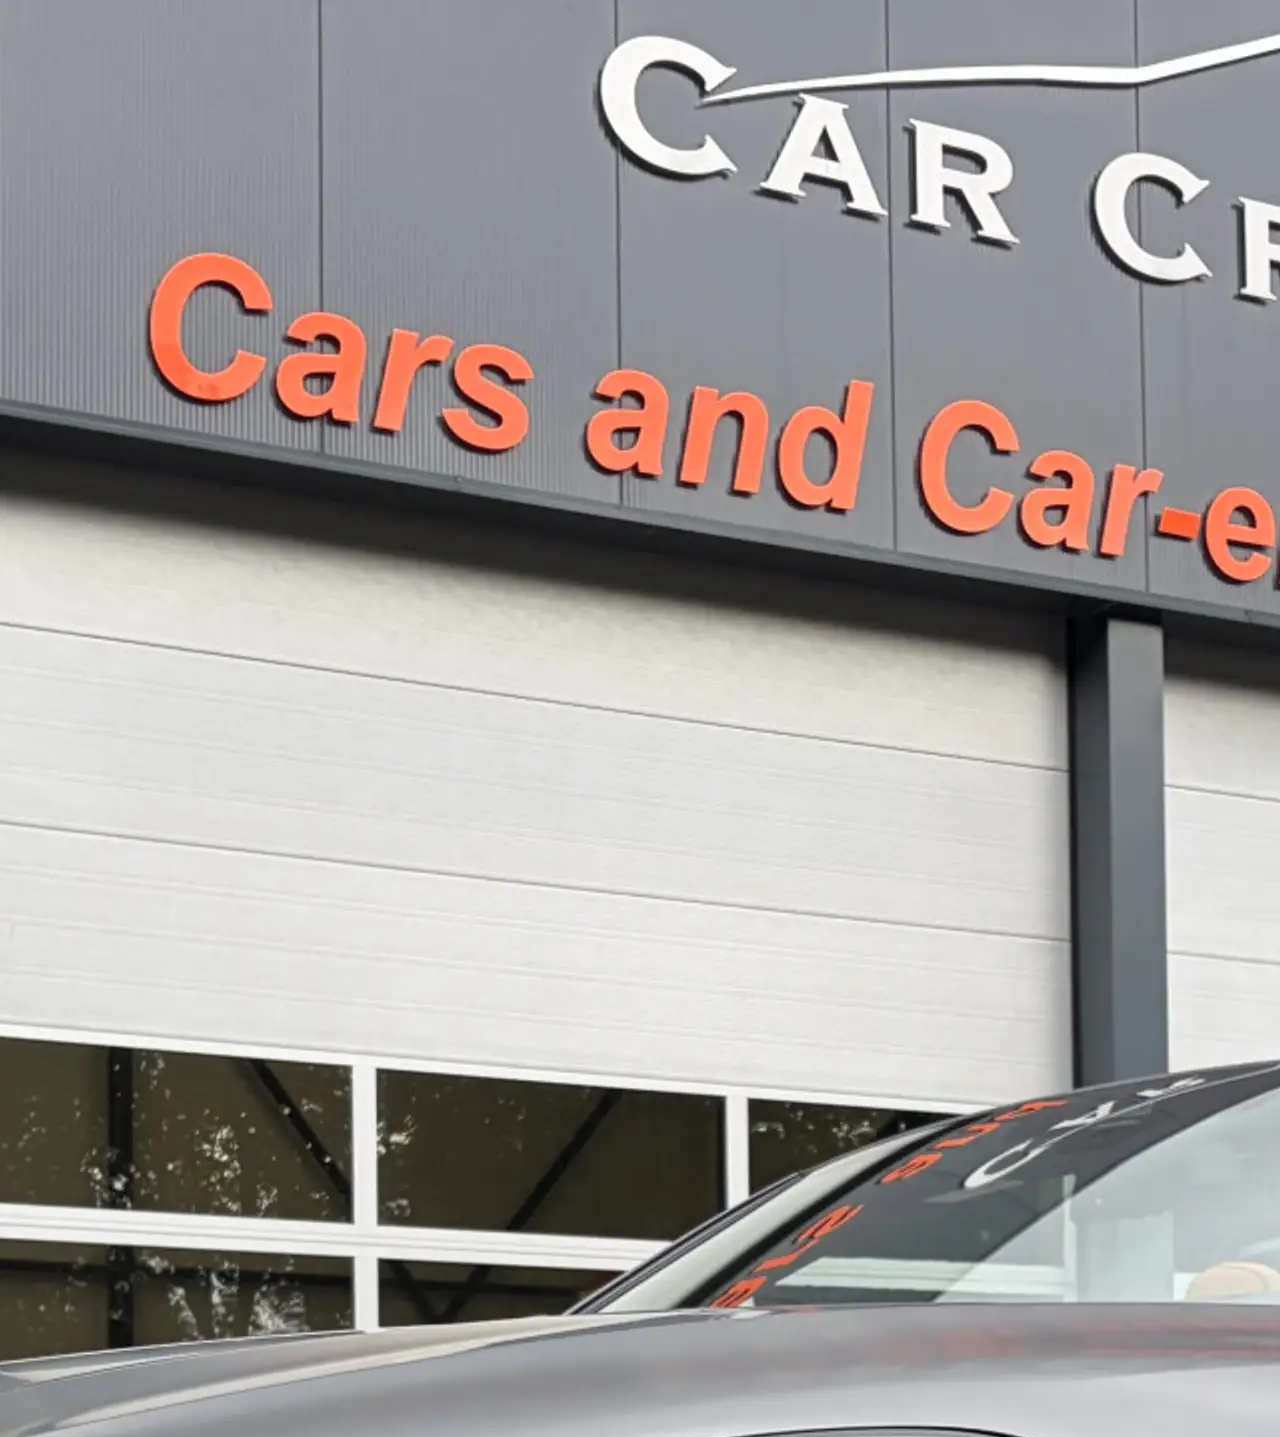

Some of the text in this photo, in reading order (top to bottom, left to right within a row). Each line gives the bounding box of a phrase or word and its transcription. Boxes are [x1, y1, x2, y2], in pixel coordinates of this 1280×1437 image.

[601, 35, 1020, 244] CAR
[150, 253, 534, 451] Cars
[586, 370, 873, 510] and
